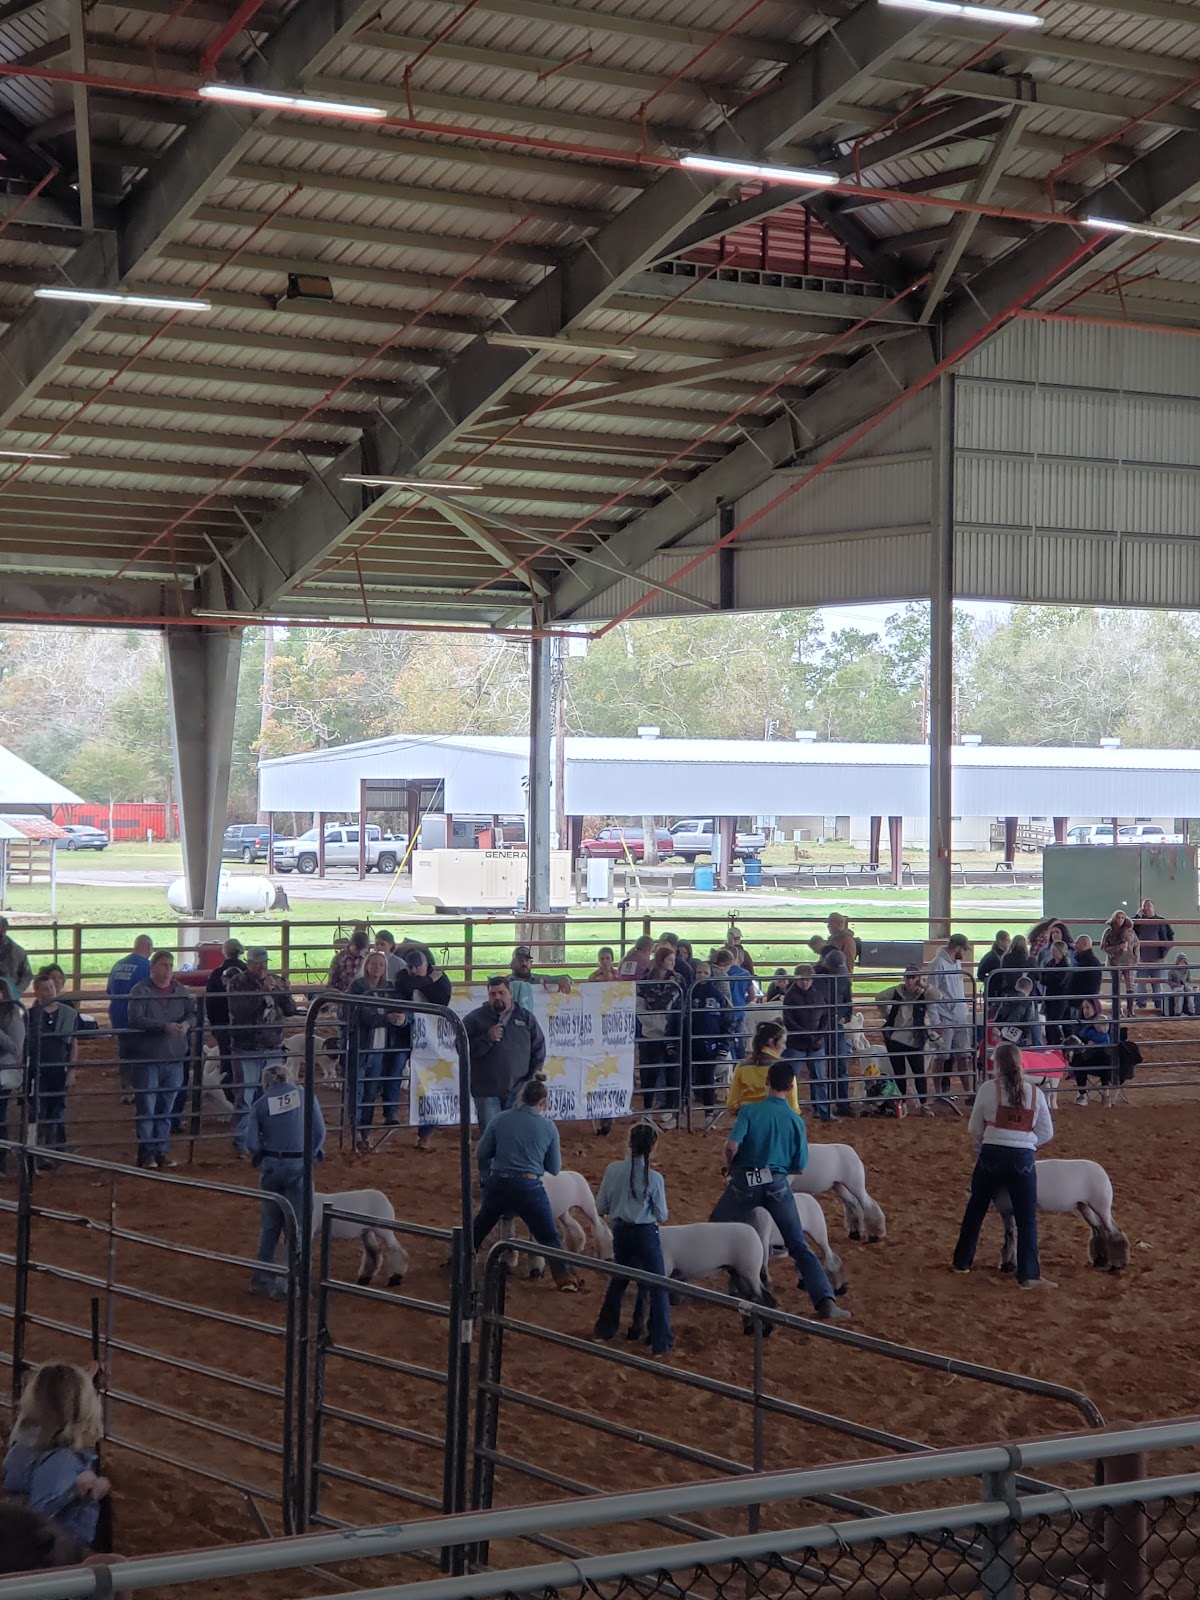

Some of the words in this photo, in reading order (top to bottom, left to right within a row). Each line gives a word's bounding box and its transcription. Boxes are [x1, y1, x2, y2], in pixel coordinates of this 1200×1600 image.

[485, 851, 528, 859] GENERA
[548, 1015, 571, 1036] RISING
[572, 1014, 592, 1036] STARS
[601, 1013, 622, 1035] RISING
[623, 1012, 635, 1033] STA
[277, 1094, 291, 1107] 75
[418, 1095, 442, 1117] RISING
[442, 1095, 459, 1116] STAR
[586, 1091, 608, 1111] RISING
[608, 1089, 628, 1108] STARS
[747, 1171, 762, 1185] 78
